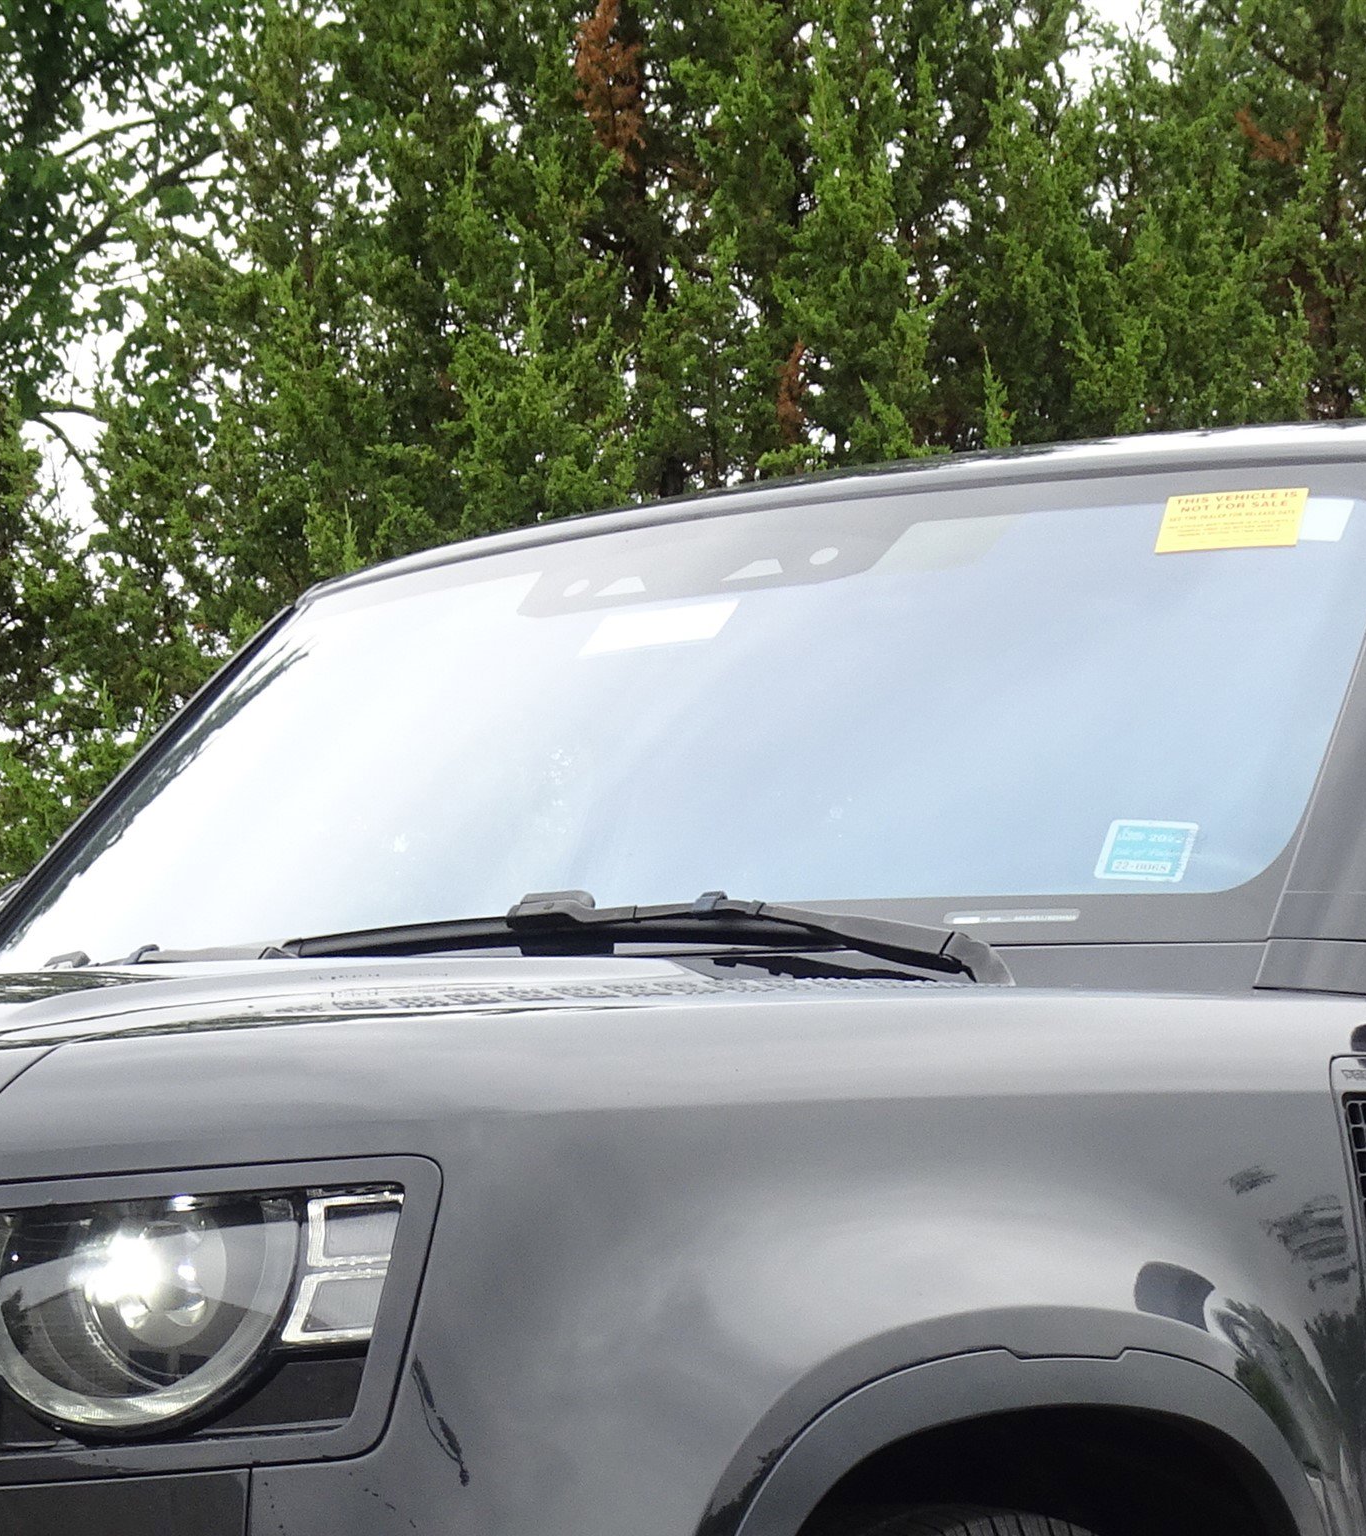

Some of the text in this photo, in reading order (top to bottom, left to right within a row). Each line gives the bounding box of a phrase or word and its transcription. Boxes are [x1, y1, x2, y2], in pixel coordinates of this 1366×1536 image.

[1176, 497, 1210, 505] THIS
[1216, 492, 1280, 502] VEHICLE
[1180, 500, 1289, 513] NOT FOR SALE
